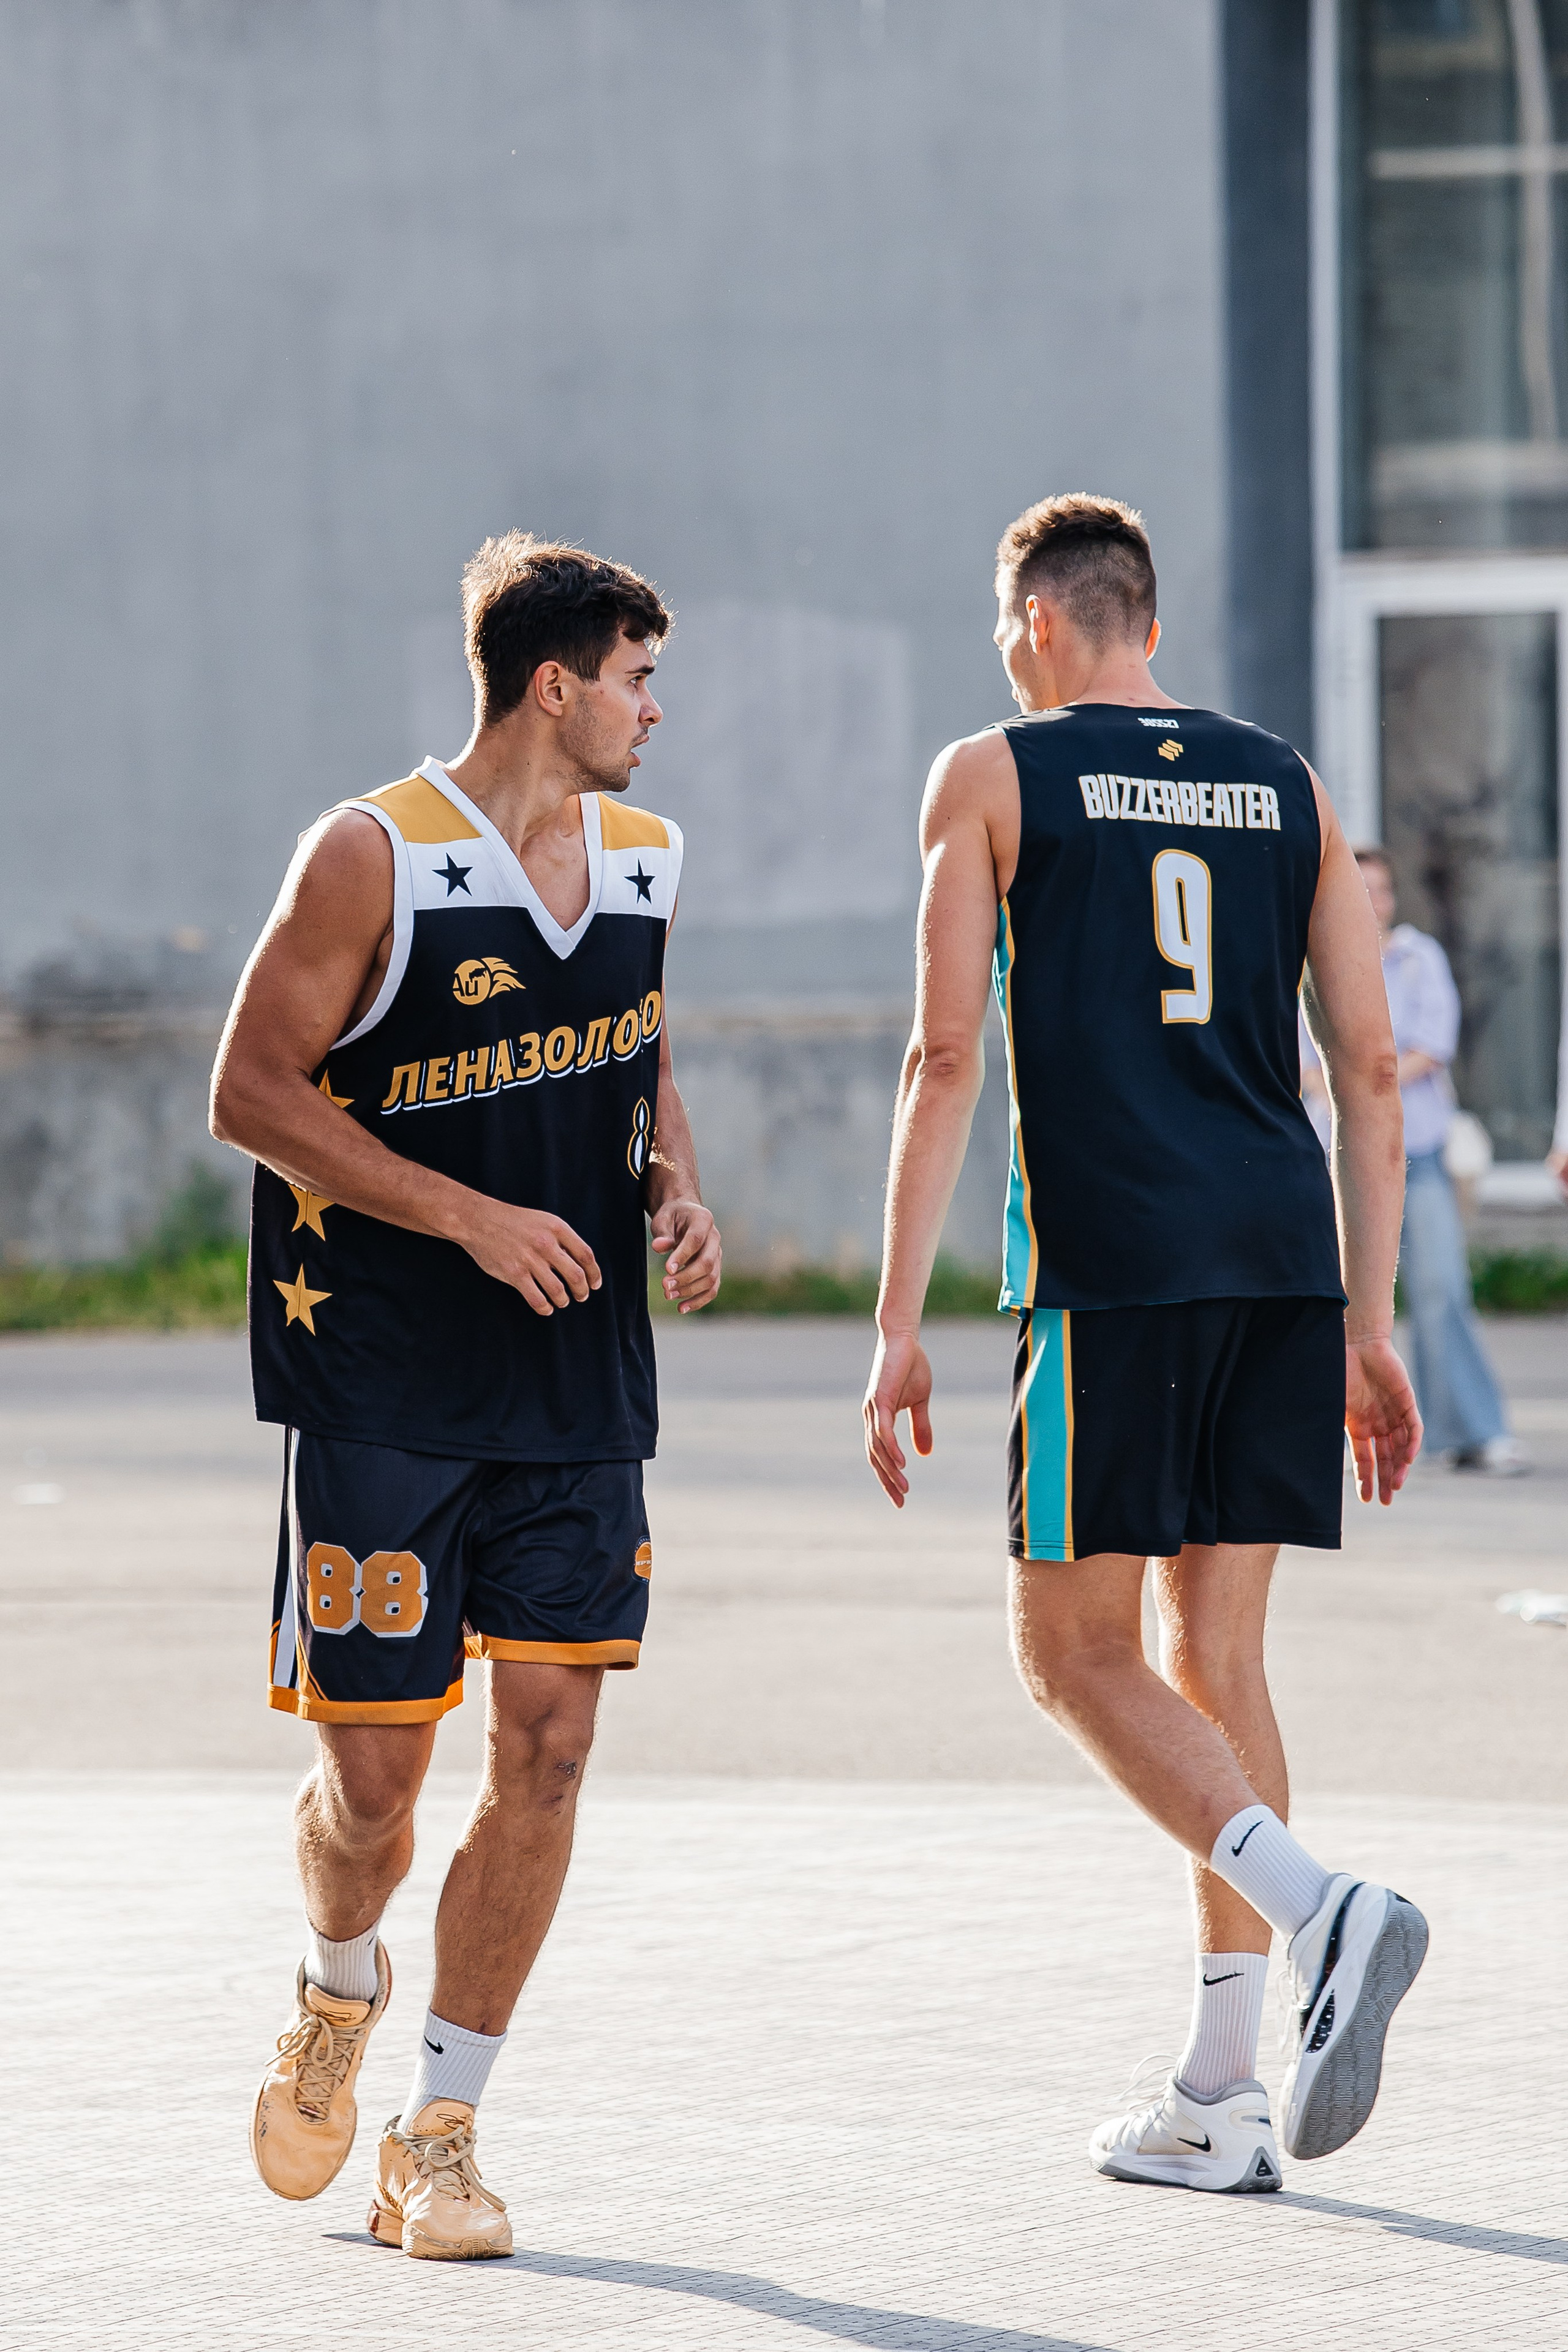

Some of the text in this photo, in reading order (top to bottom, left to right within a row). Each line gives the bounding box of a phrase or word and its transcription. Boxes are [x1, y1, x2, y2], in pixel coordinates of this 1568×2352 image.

[1079, 774, 1281, 830] BUZZERBEATER
[1152, 849, 1212, 1024] 9
[380, 990, 662, 1115] ЛЕНАЗОЛОО
[306, 1541, 429, 1638] 88
